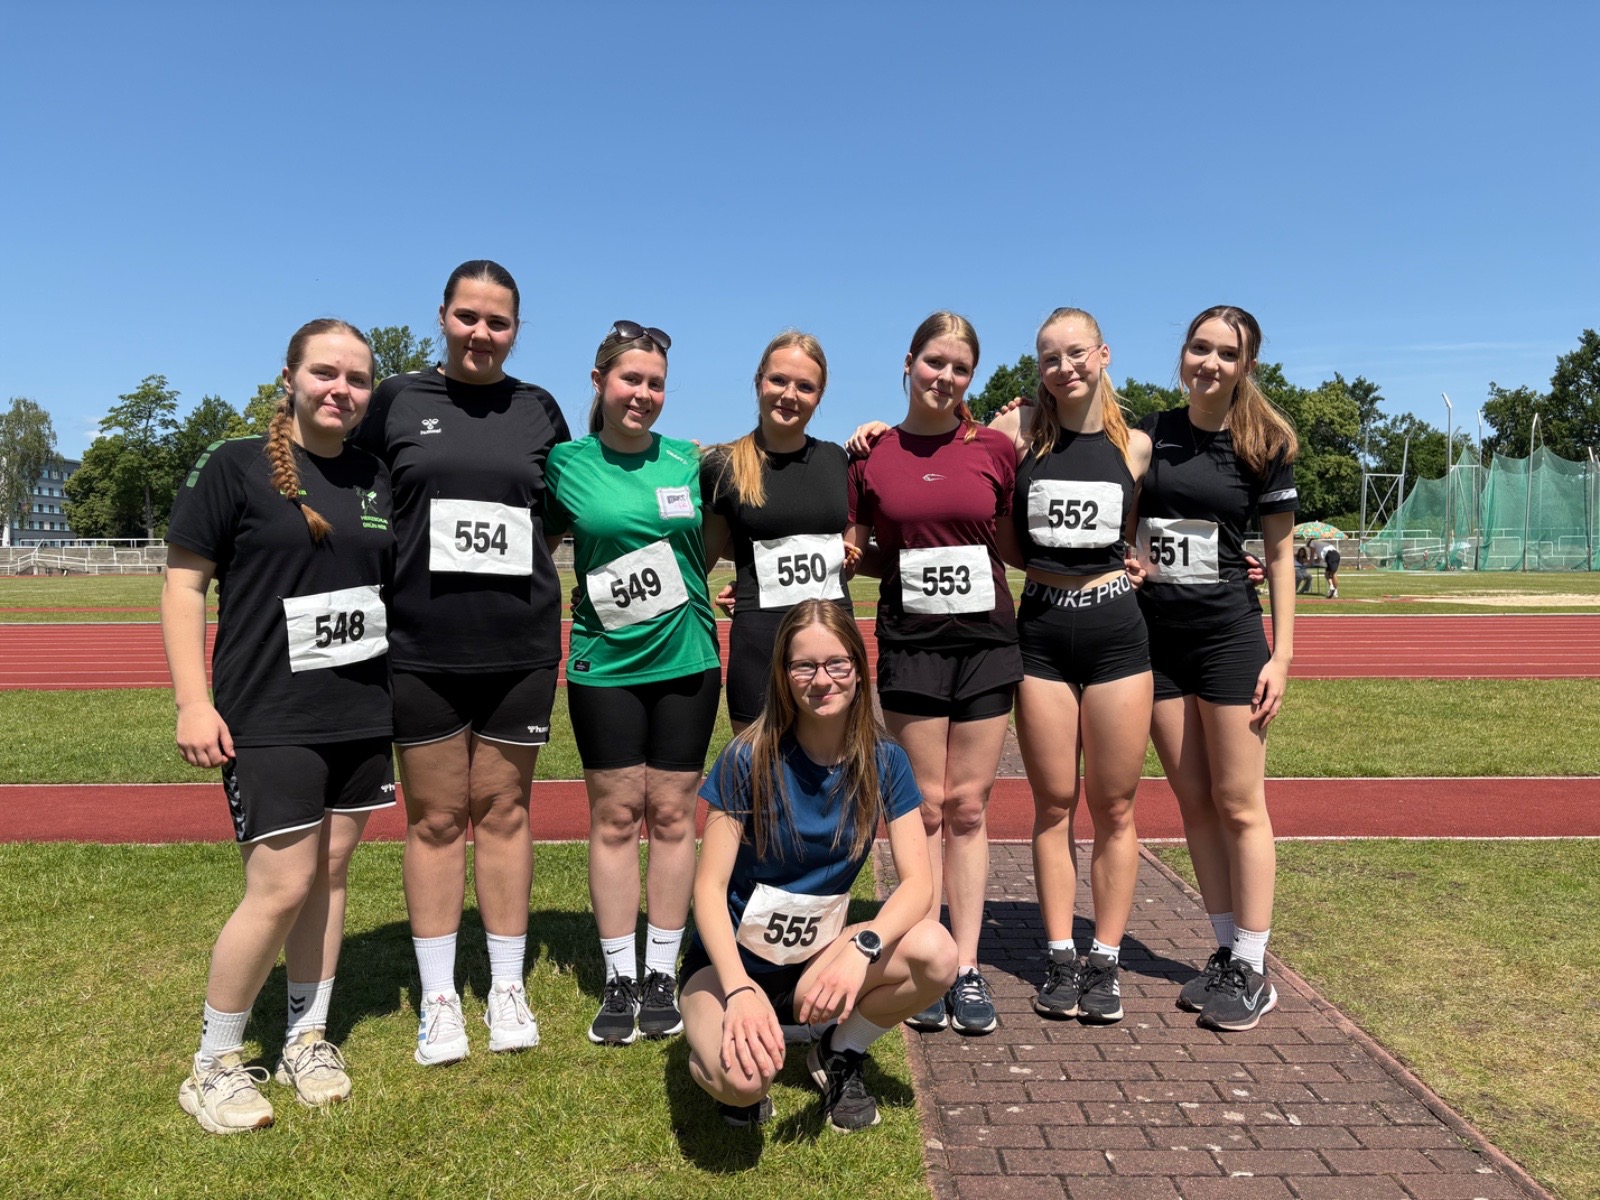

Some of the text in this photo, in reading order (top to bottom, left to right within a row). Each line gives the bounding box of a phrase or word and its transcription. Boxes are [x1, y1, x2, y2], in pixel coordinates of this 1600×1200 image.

[1047, 499, 1099, 531] 552
[455, 520, 508, 555] 554
[1149, 536, 1189, 567] 551
[777, 552, 827, 587] 550
[921, 565, 971, 597] 553
[610, 567, 662, 609] 549
[1042, 586, 1092, 608] NIKE
[1097, 575, 1131, 603] PRO
[315, 610, 365, 649] 548
[763, 912, 822, 948] 555
